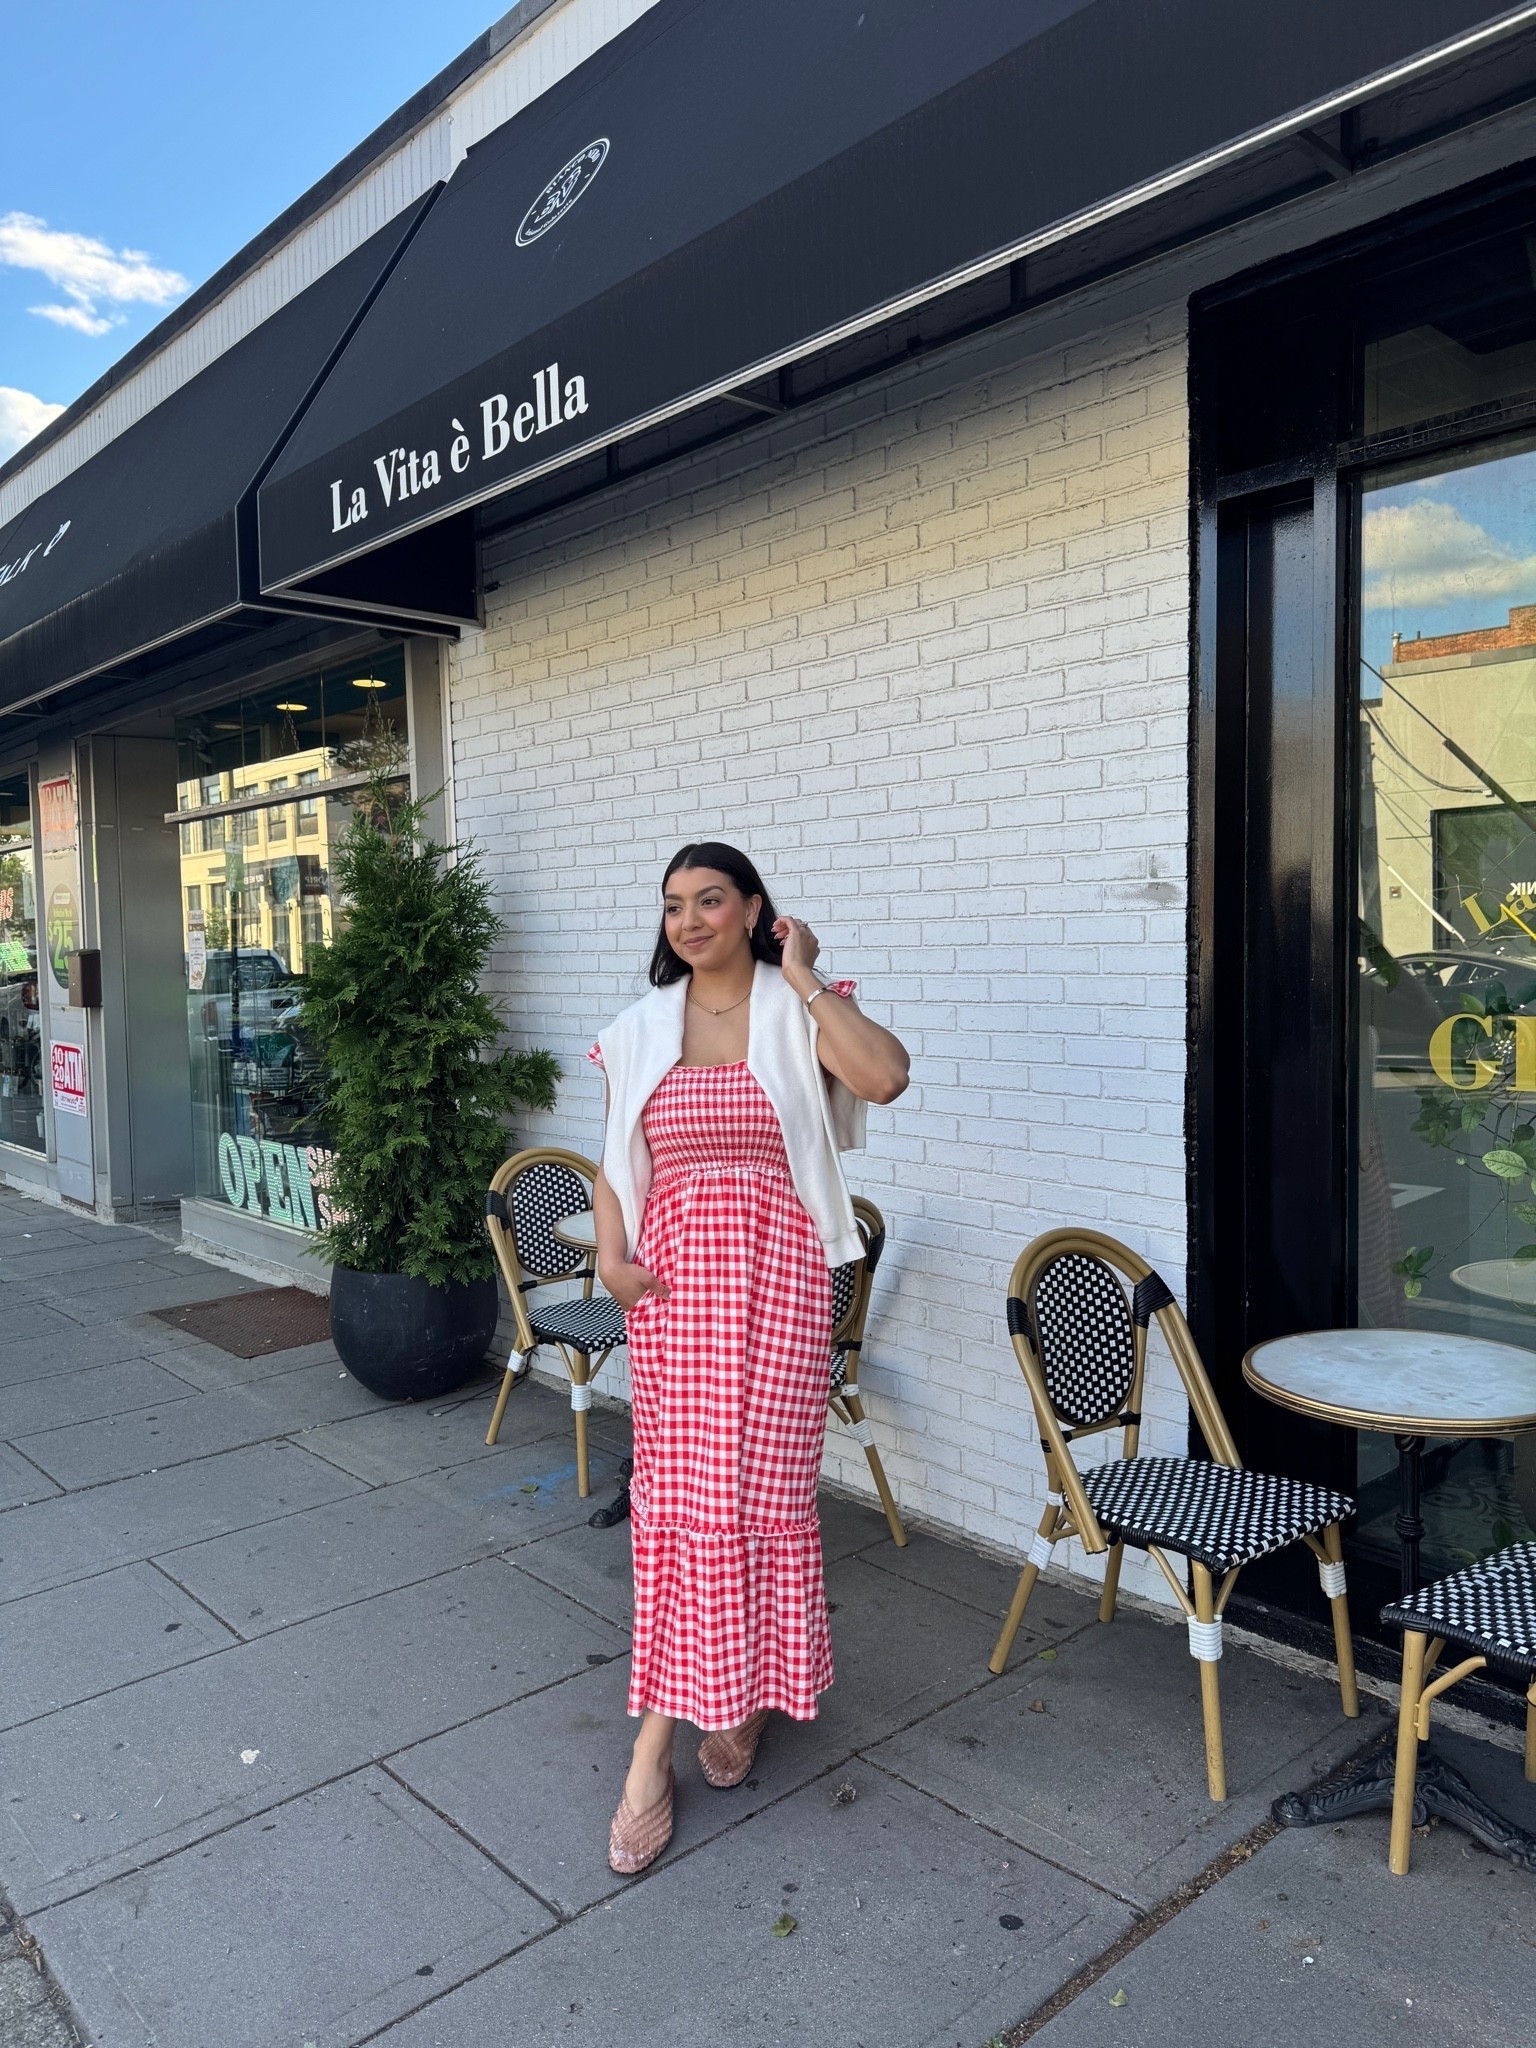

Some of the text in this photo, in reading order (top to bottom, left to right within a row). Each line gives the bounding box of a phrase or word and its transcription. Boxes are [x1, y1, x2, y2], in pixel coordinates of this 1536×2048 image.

[330, 362, 589, 533] La Vita è Bella
[64, 1050, 84, 1093] ATM
[218, 1131, 318, 1231] OPEN
